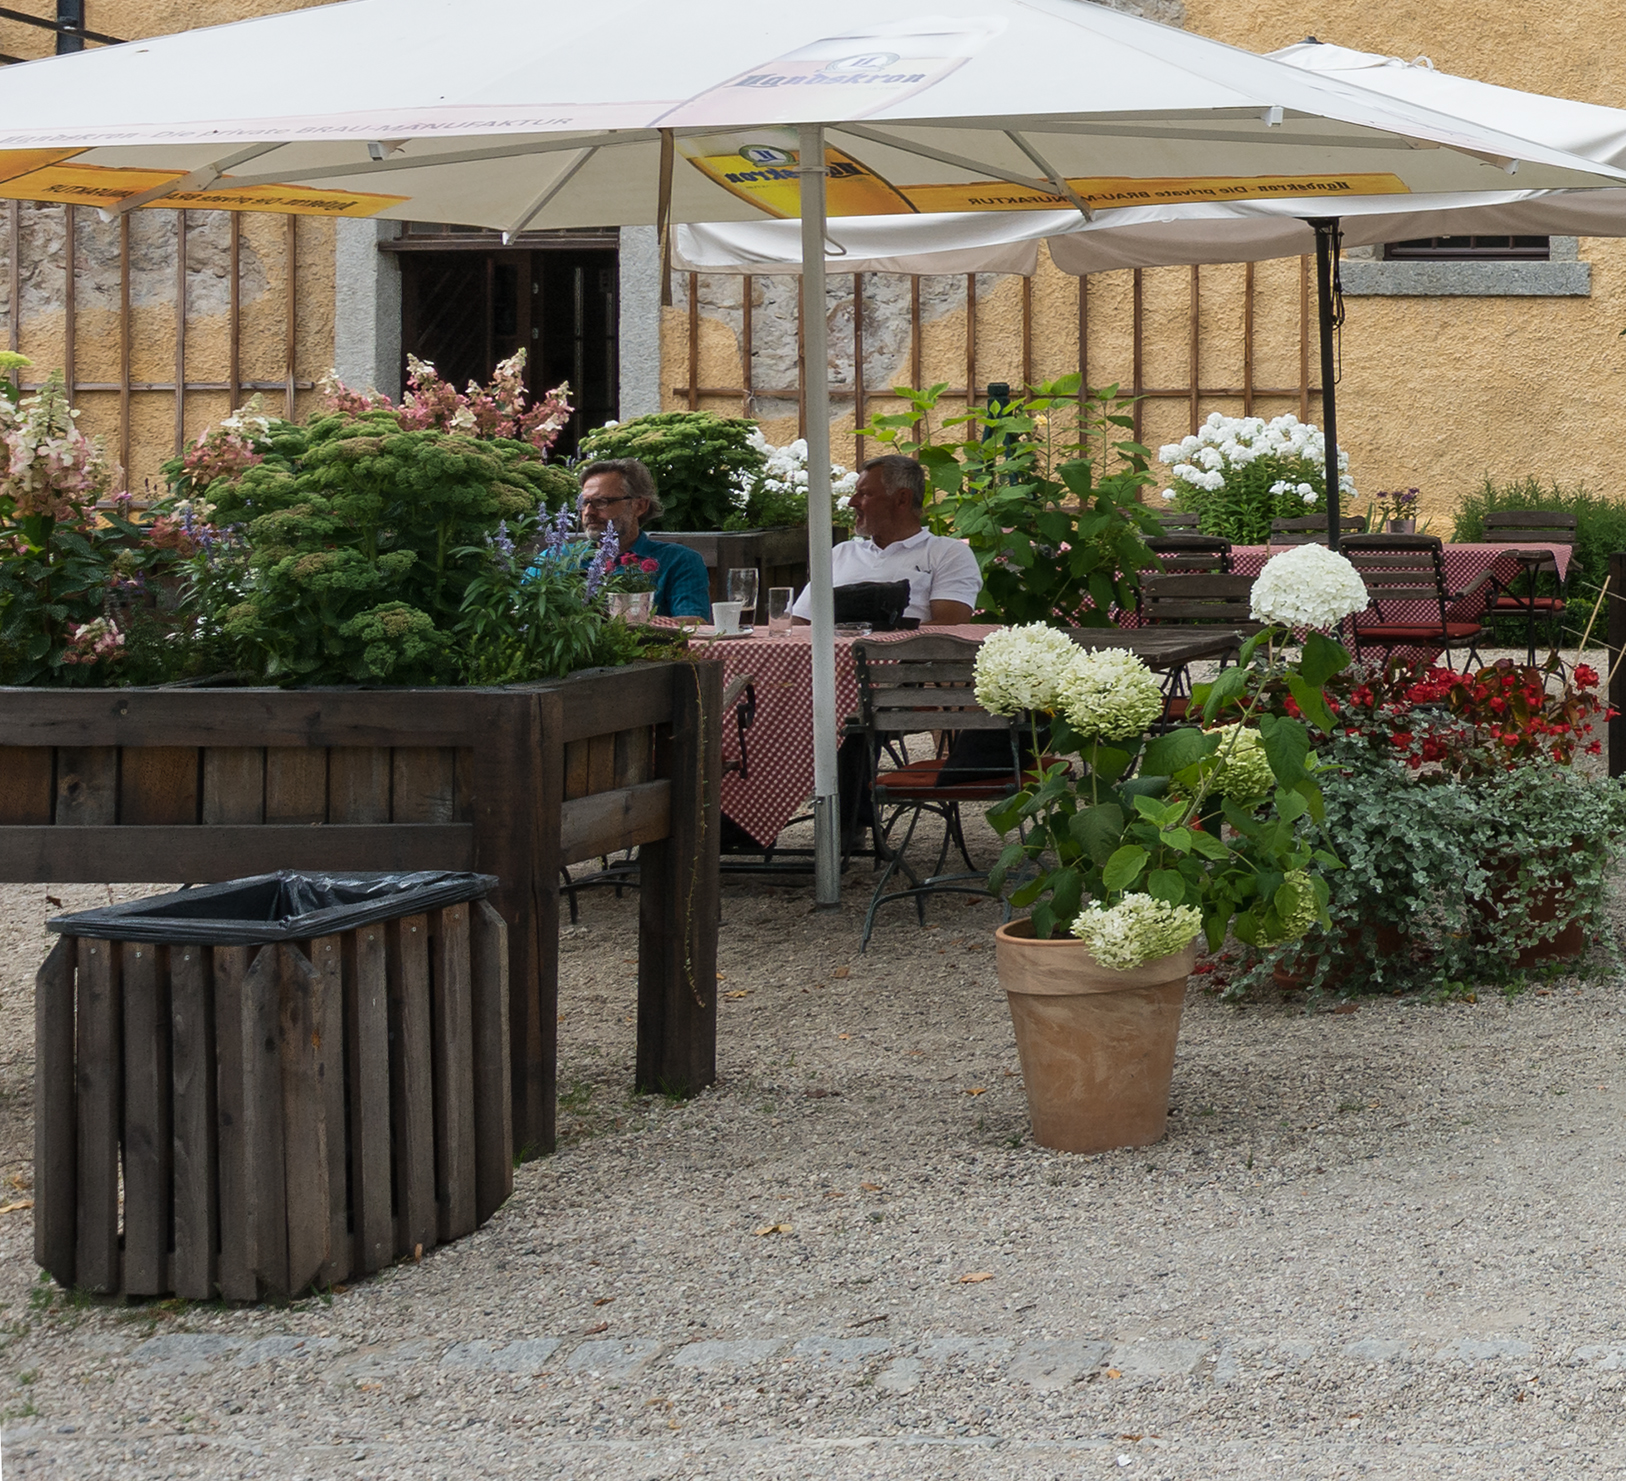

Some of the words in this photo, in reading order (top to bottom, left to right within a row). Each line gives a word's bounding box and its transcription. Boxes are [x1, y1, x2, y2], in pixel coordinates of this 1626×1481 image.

[723, 72, 927, 88] Landskron
[150, 129, 196, 139] Die
[195, 127, 292, 140] private
[295, 117, 575, 134] BRAU-MANUFAKTUR
